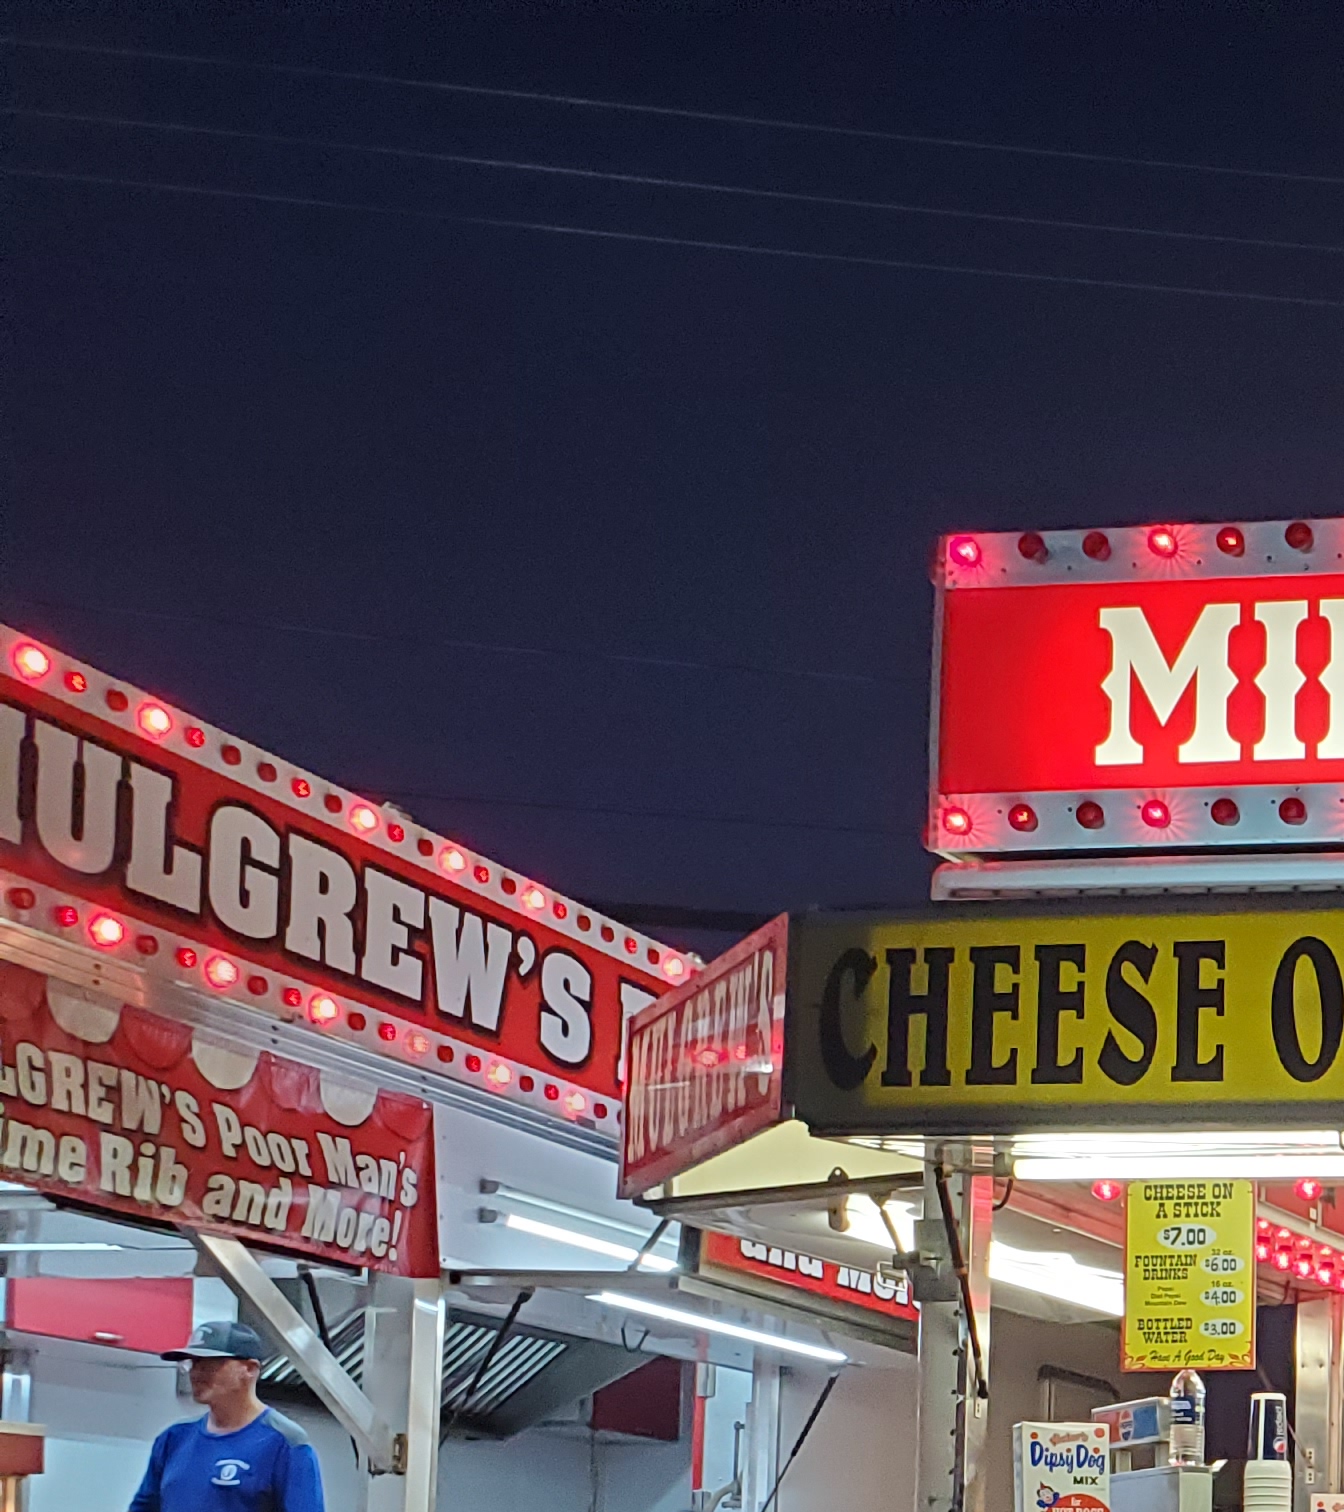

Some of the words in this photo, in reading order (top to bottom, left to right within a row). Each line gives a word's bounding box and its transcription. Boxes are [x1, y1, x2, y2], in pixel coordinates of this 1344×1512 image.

[0, 703, 592, 1065] ULGREW'S
[820, 940, 1226, 1091] CHEESE
[212, 1102, 311, 1177] Poor
[317, 1132, 417, 1207] Man's
[100, 1131, 188, 1207] Rib
[202, 1174, 292, 1232] and
[302, 1183, 401, 1262] More!
[1144, 1184, 1206, 1201] CHEESE
[1212, 1183, 1234, 1200] ON
[1156, 1203, 1168, 1219] A
[1173, 1202, 1221, 1218] STICK
[1164, 1227, 1206, 1246] $7.00
[1134, 1254, 1197, 1268] FOUNTAIN
[1142, 1268, 1188, 1280] DRINKS
[1137, 1318, 1192, 1331] BOTTLED
[1142, 1331, 1188, 1344] WATER
[1206, 1350, 1225, 1364] Day
[1030, 1440, 1074, 1473] Dipsy
[1076, 1444, 1105, 1475] Dog
[1073, 1476, 1098, 1486] MIX
